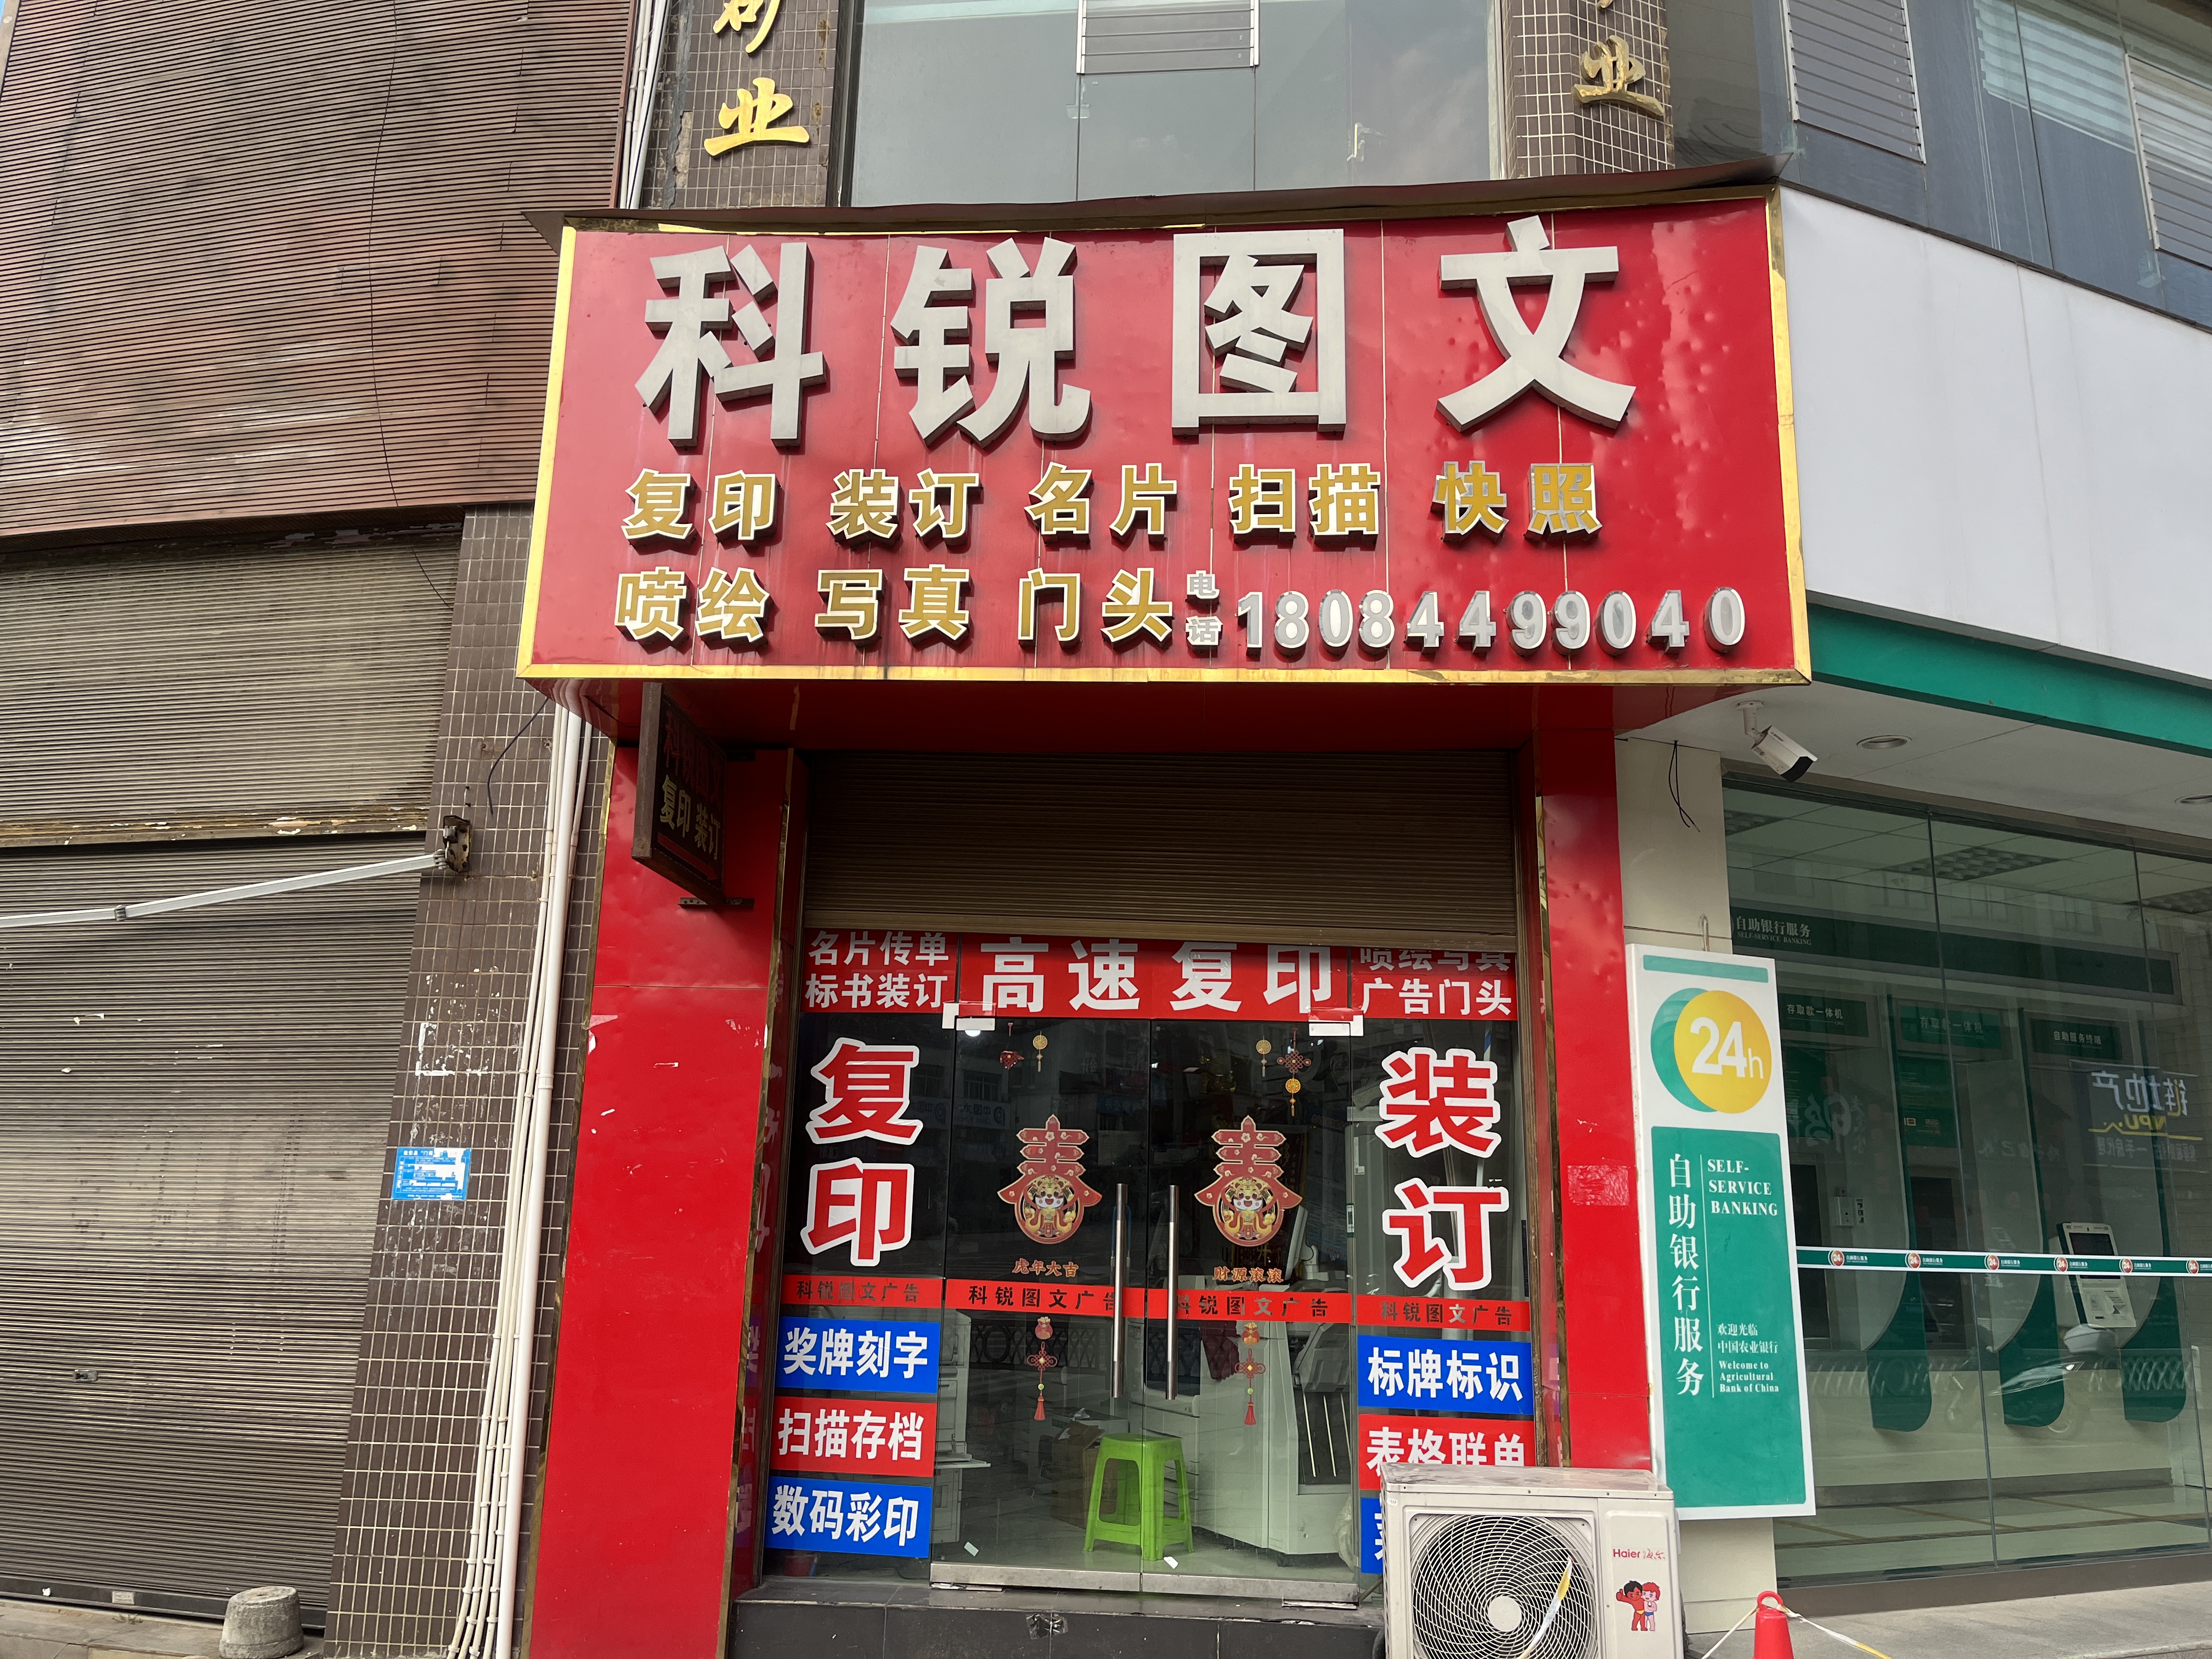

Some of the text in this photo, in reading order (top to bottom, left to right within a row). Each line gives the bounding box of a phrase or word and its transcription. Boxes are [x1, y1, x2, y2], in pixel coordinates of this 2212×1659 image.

[635, 215, 1637, 447] 科锐图文
[622, 461, 1602, 544] 复印 装订 名片 扫描 快照
[614, 565, 1173, 646] 喷绘 写真 门头
[1186, 571, 1222, 652] 电话
[1236, 586, 1746, 655] 18084499040
[659, 774, 721, 861] 复印 装订
[1736, 916, 1811, 938] 自助银行服务
[1737, 932, 1812, 946] SELF-SERVICE BANKING
[808, 930, 949, 966] 名片传单
[805, 973, 948, 1008] 标书装订
[980, 936, 1331, 1014] 高速复印
[1360, 977, 1511, 1015] 广告门头
[1690, 1017, 1764, 1080] 24h
[801, 1037, 923, 1267] 复印
[1375, 1047, 1509, 1291] 装订
[1707, 1158, 1750, 1173] SELF-
[1708, 1179, 1772, 1196] SERVICE
[1711, 1200, 1778, 1217] BANKING
[1011, 1257, 1080, 1278] 虎年大吉
[1211, 1266, 1283, 1284] 财源滚滚
[1669, 1153, 1704, 1396] 自助银行服务
[796, 1280, 920, 1304] 科锐图文广告
[968, 1284, 1116, 1312] 科锐图文广告
[1380, 1301, 1513, 1326] 科锐图文广告
[1717, 1323, 1758, 1336] 欢迎光临
[783, 1325, 928, 1379] 奖牌刻字
[1718, 1340, 1778, 1353] 中国农业银行
[1368, 1346, 1523, 1402] 标牌标识
[1718, 1361, 1769, 1369] Welcome to
[1720, 1372, 1774, 1383] Agricultural
[1719, 1383, 1779, 1392] Bank of China
[777, 1408, 923, 1461] 扫描存档
[1366, 1426, 1525, 1477] 表格联单
[771, 1485, 919, 1547] 数码彩印
[1612, 1548, 1641, 1559] Haier
